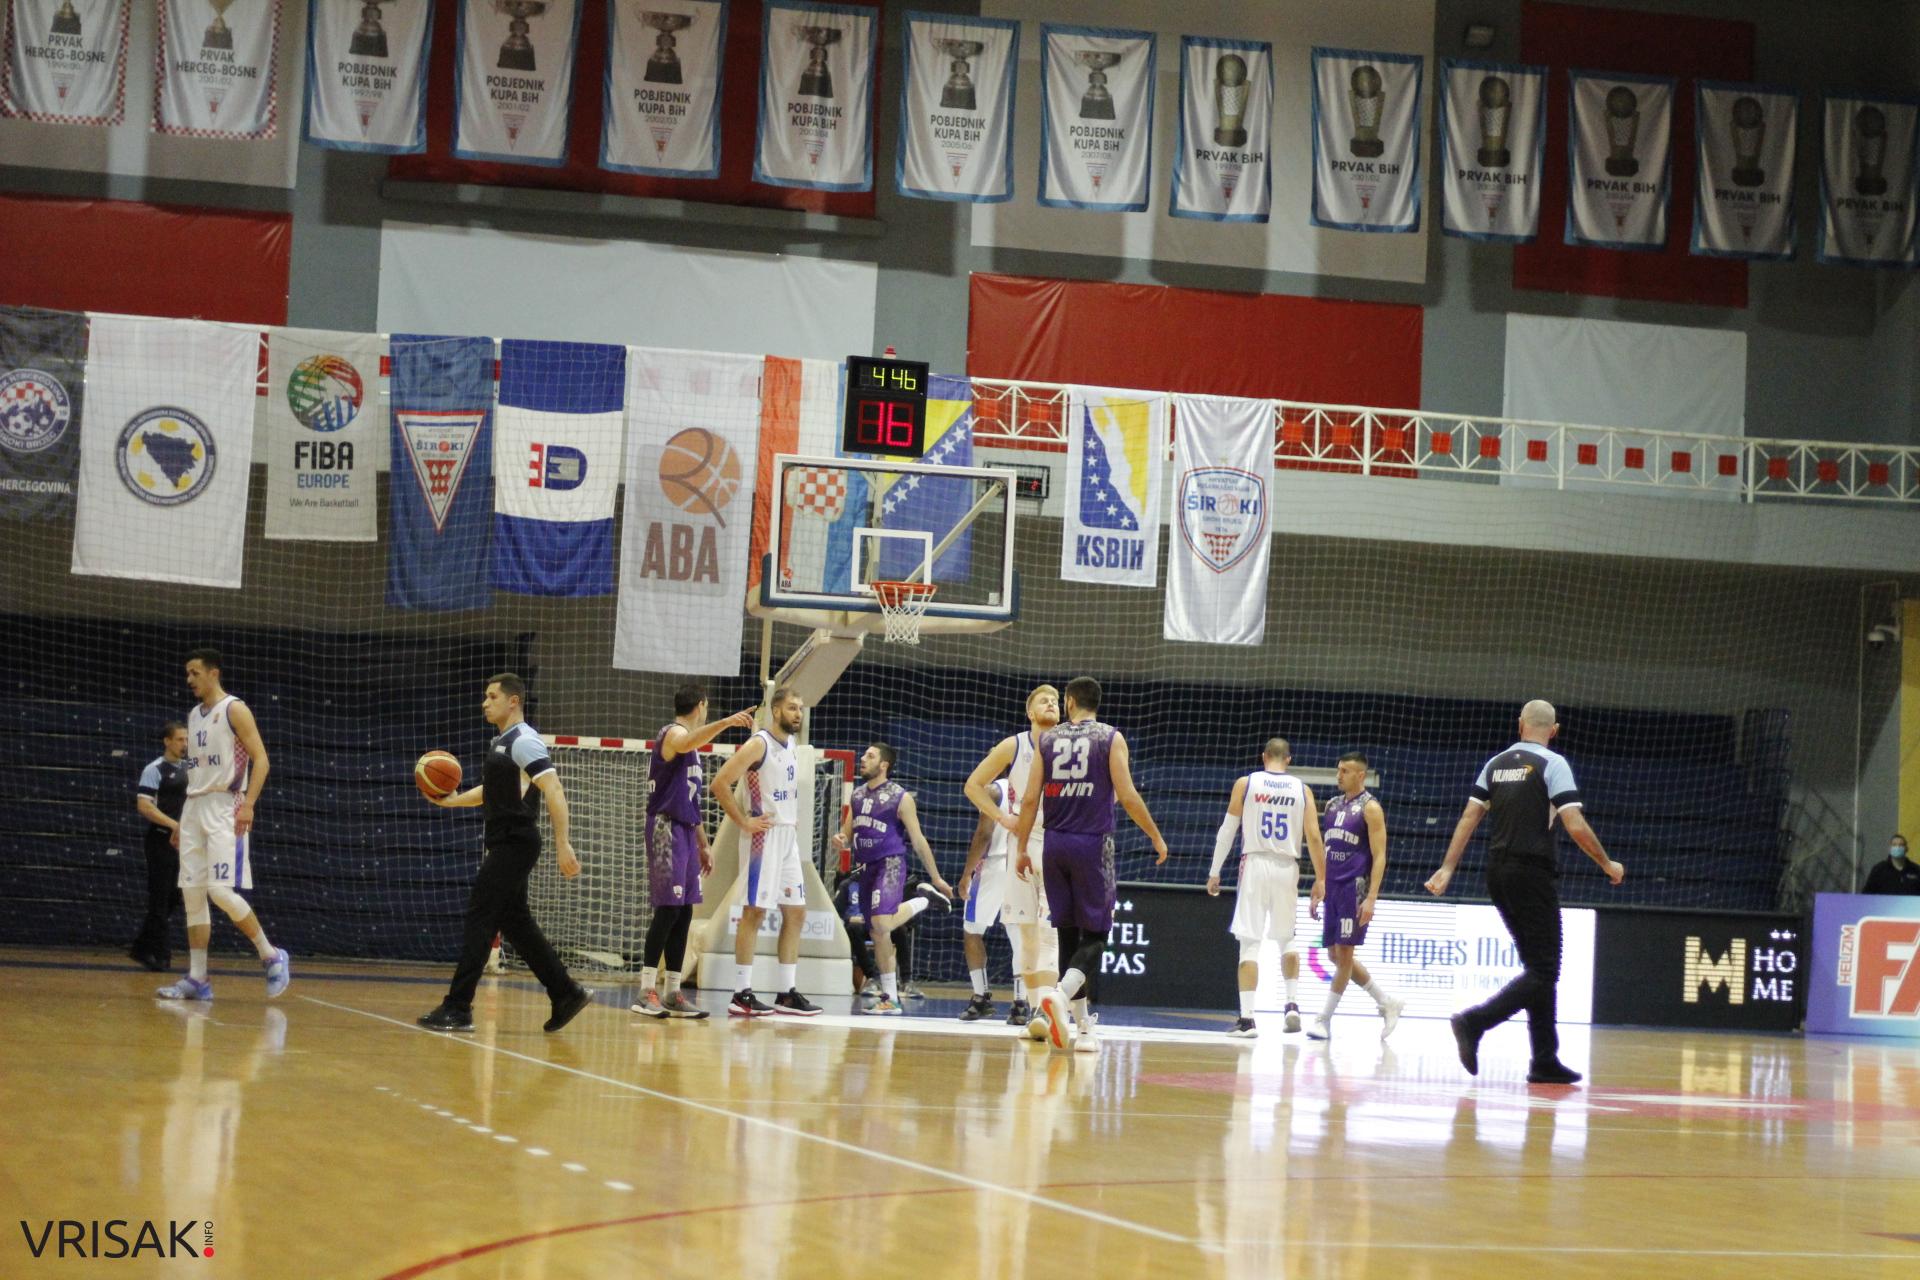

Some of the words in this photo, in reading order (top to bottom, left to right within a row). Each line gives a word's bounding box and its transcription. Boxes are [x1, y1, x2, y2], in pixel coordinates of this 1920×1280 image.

[48, 35, 84, 50] PRVAK
[24, 46, 106, 63] HERCEG-BOSNE
[200, 50, 235, 64] PRVAK
[176, 61, 257, 78] HERCEG-BOSNE
[338, 62, 398, 79] POBJEDNIK
[342, 75, 371, 88] KUPA
[373, 78, 391, 90] BiH
[486, 75, 545, 91] POBJEDNIK
[490, 89, 519, 101] KUPA
[522, 91, 540, 103] BiH
[634, 89, 692, 104] POBJEDNIK
[638, 102, 666, 115] KUPA
[668, 104, 686, 117] BiH
[788, 103, 843, 118] POBJEDNIK
[791, 115, 818, 127] KUPA
[820, 118, 837, 130] BiH
[931, 115, 986, 130] POBJEDNIK
[934, 128, 961, 140] KUPA
[963, 130, 980, 142] BiH
[1070, 126, 1125, 140] POBJEDNIK
[1074, 139, 1101, 150] KUPA
[1103, 140, 1120, 152] BiH
[1196, 149, 1238, 164] PRVAK
[1331, 160, 1374, 173] PRVAK
[1458, 169, 1501, 183] PRVAK
[1587, 178, 1628, 192] PRVAK
[294, 441, 354, 471] FIBA
[0, 479, 71, 494] HERCEGOVINA
[297, 473, 350, 489] EUROPE
[640, 521, 720, 584] ABA
[1075, 534, 1145, 570] KSBIH
[195, 730, 208, 748] 12
[1052, 737, 1090, 780] 23
[861, 798, 874, 814] 16
[1260, 811, 1289, 841] 55
[1334, 810, 1346, 827] 10
[213, 863, 229, 882] 12
[1339, 917, 1354, 934] 10
[1107, 922, 1150, 946] TEL
[1752, 947, 1797, 973] HO
[1751, 977, 1794, 1001] ME
